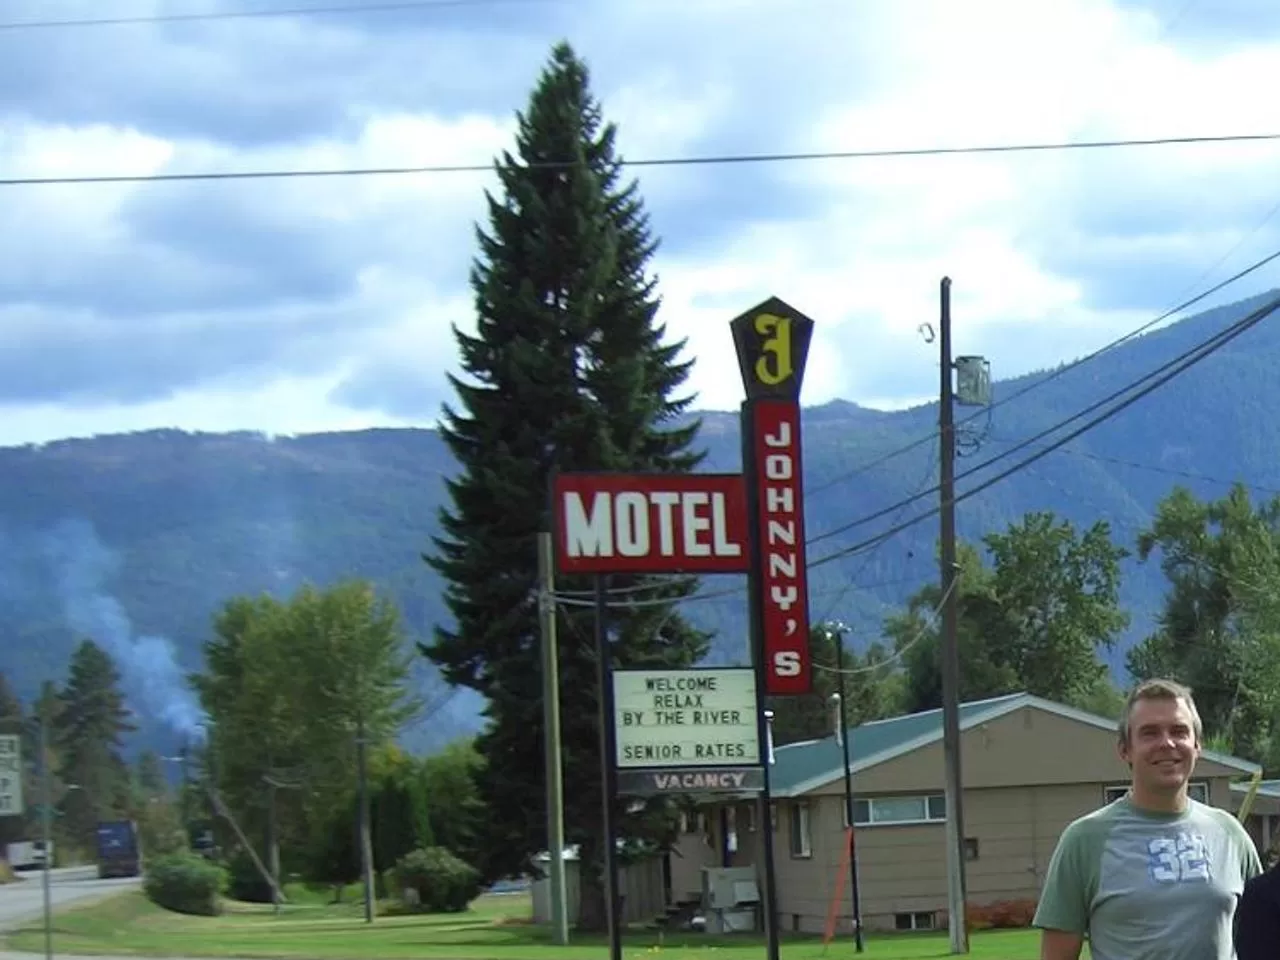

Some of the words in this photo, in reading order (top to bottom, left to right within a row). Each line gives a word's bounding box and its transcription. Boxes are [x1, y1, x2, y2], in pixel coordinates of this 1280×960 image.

[563, 491, 741, 558] MOTEL
[764, 421, 801, 678] JOHNNY'S
[646, 677, 717, 691] WELCOME
[654, 694, 703, 708] RELAX
[623, 711, 644, 726] BY
[656, 711, 685, 724] THE
[693, 711, 741, 724] RIVER
[624, 745, 682, 759] SENIOR
[695, 744, 745, 757] RATES
[654, 773, 746, 789] VACANCY
